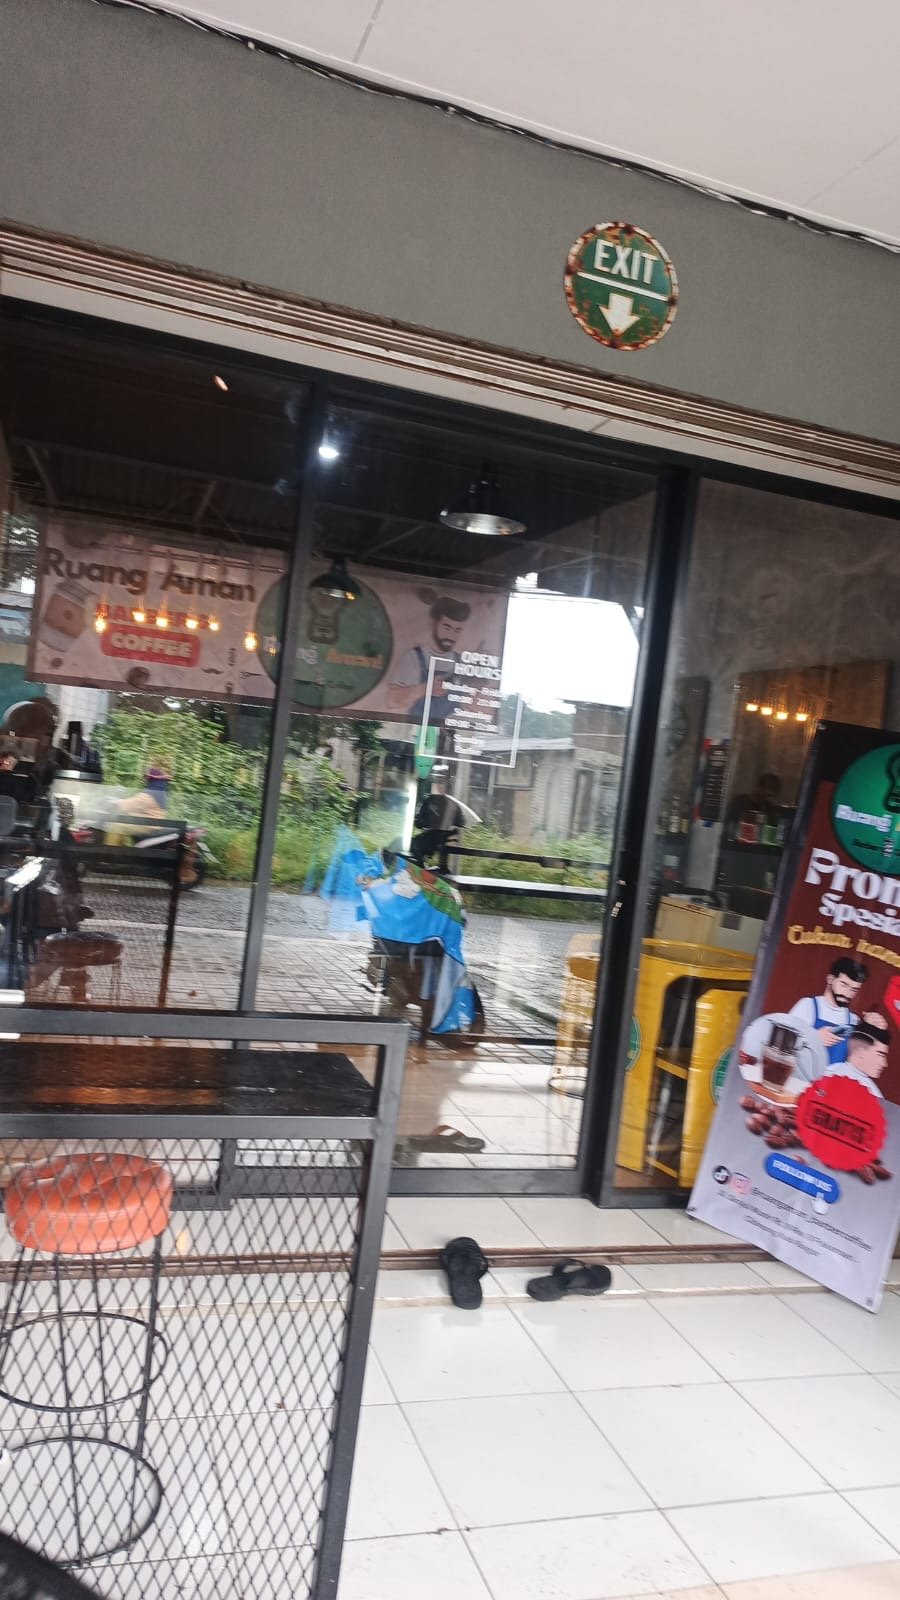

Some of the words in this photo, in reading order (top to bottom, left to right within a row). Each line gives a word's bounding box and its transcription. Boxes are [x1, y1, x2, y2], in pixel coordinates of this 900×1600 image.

[594, 239, 659, 284] EXIT
[44, 547, 148, 596] Ruang
[160, 560, 256, 602] Aman
[111, 631, 193, 658] COFFEE
[454, 662, 502, 680] HOURS
[461, 650, 499, 668] OPEN
[835, 804, 891, 833] Ruang
